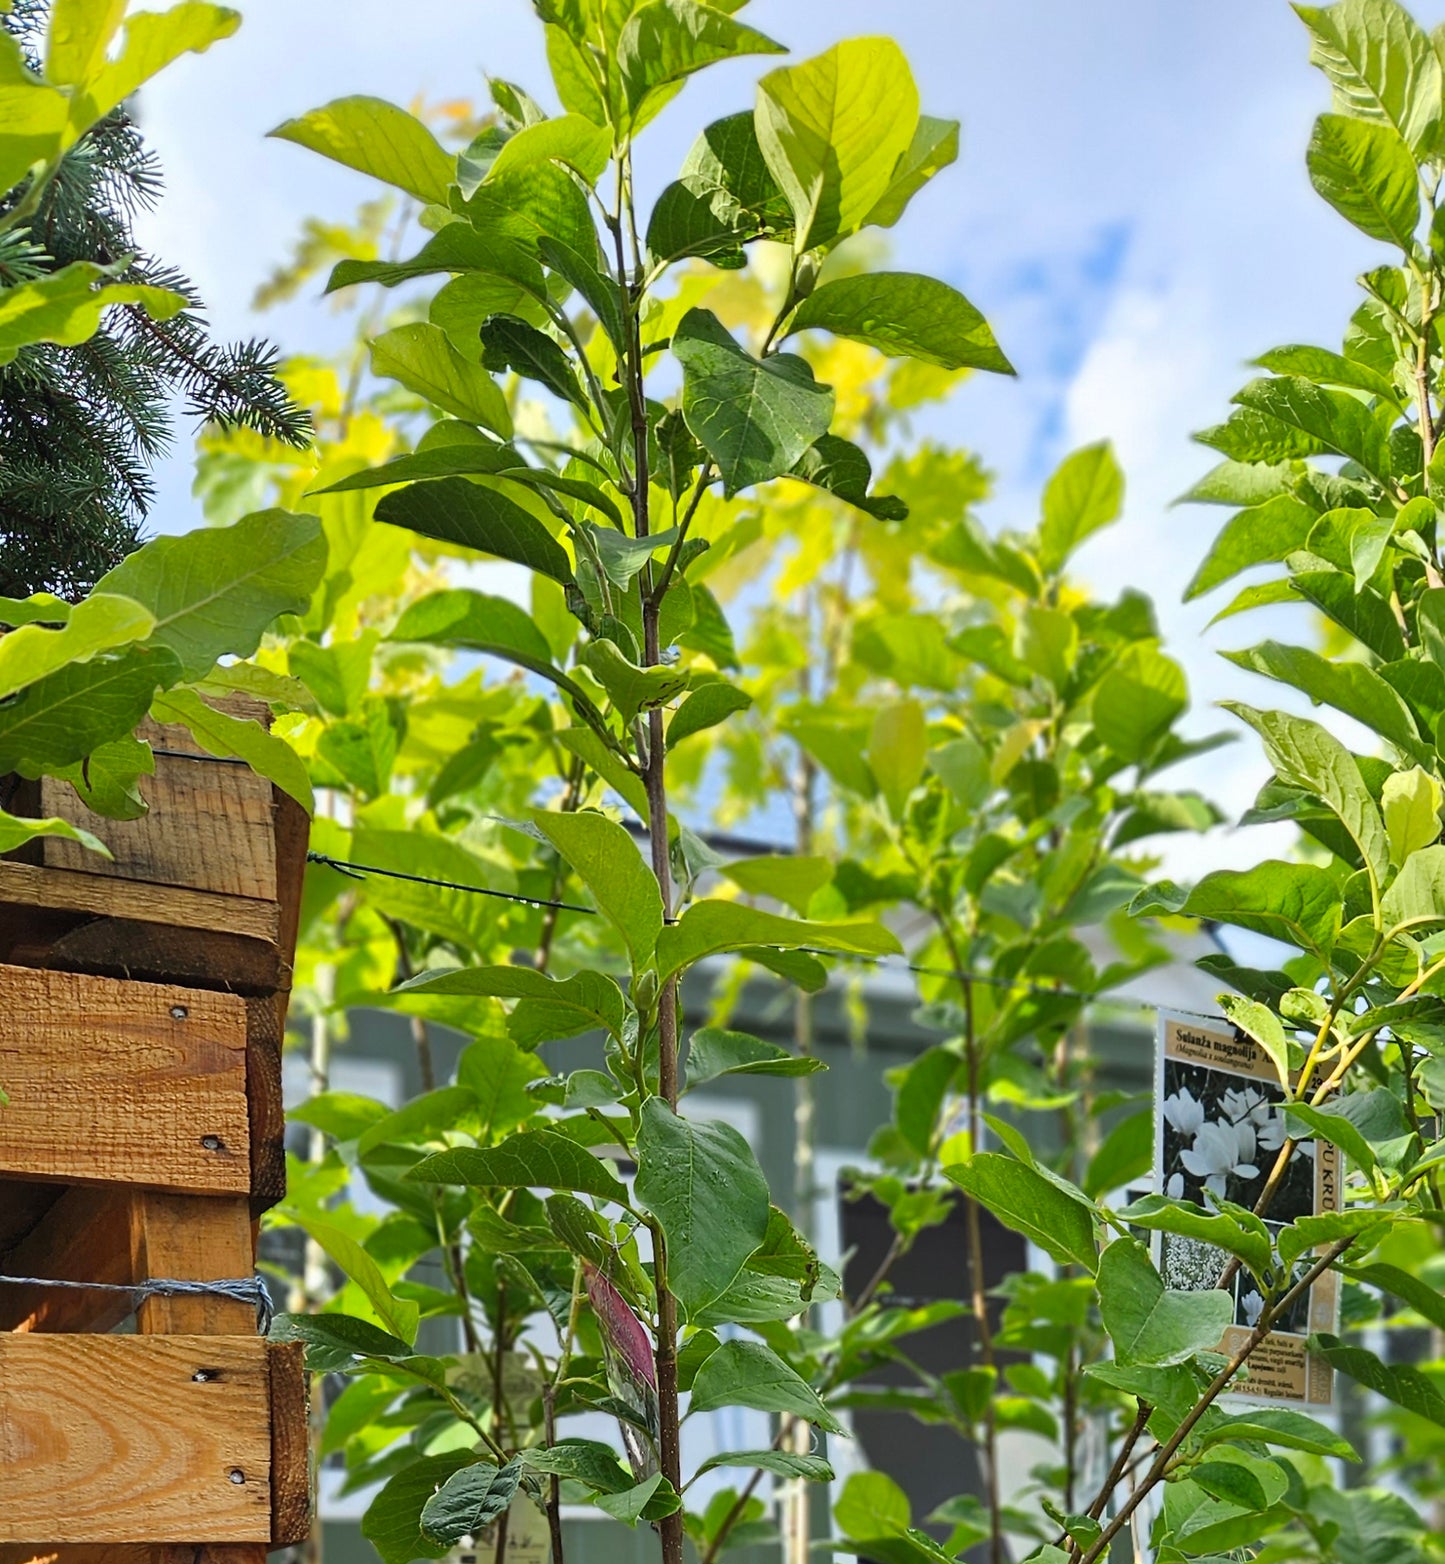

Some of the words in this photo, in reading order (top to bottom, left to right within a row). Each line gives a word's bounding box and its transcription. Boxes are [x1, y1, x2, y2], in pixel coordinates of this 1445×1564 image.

[1176, 1028, 1211, 1049] Sulanža
[1214, 1041, 1257, 1062] magnolija
[1322, 1168, 1335, 1212] KRŪ
